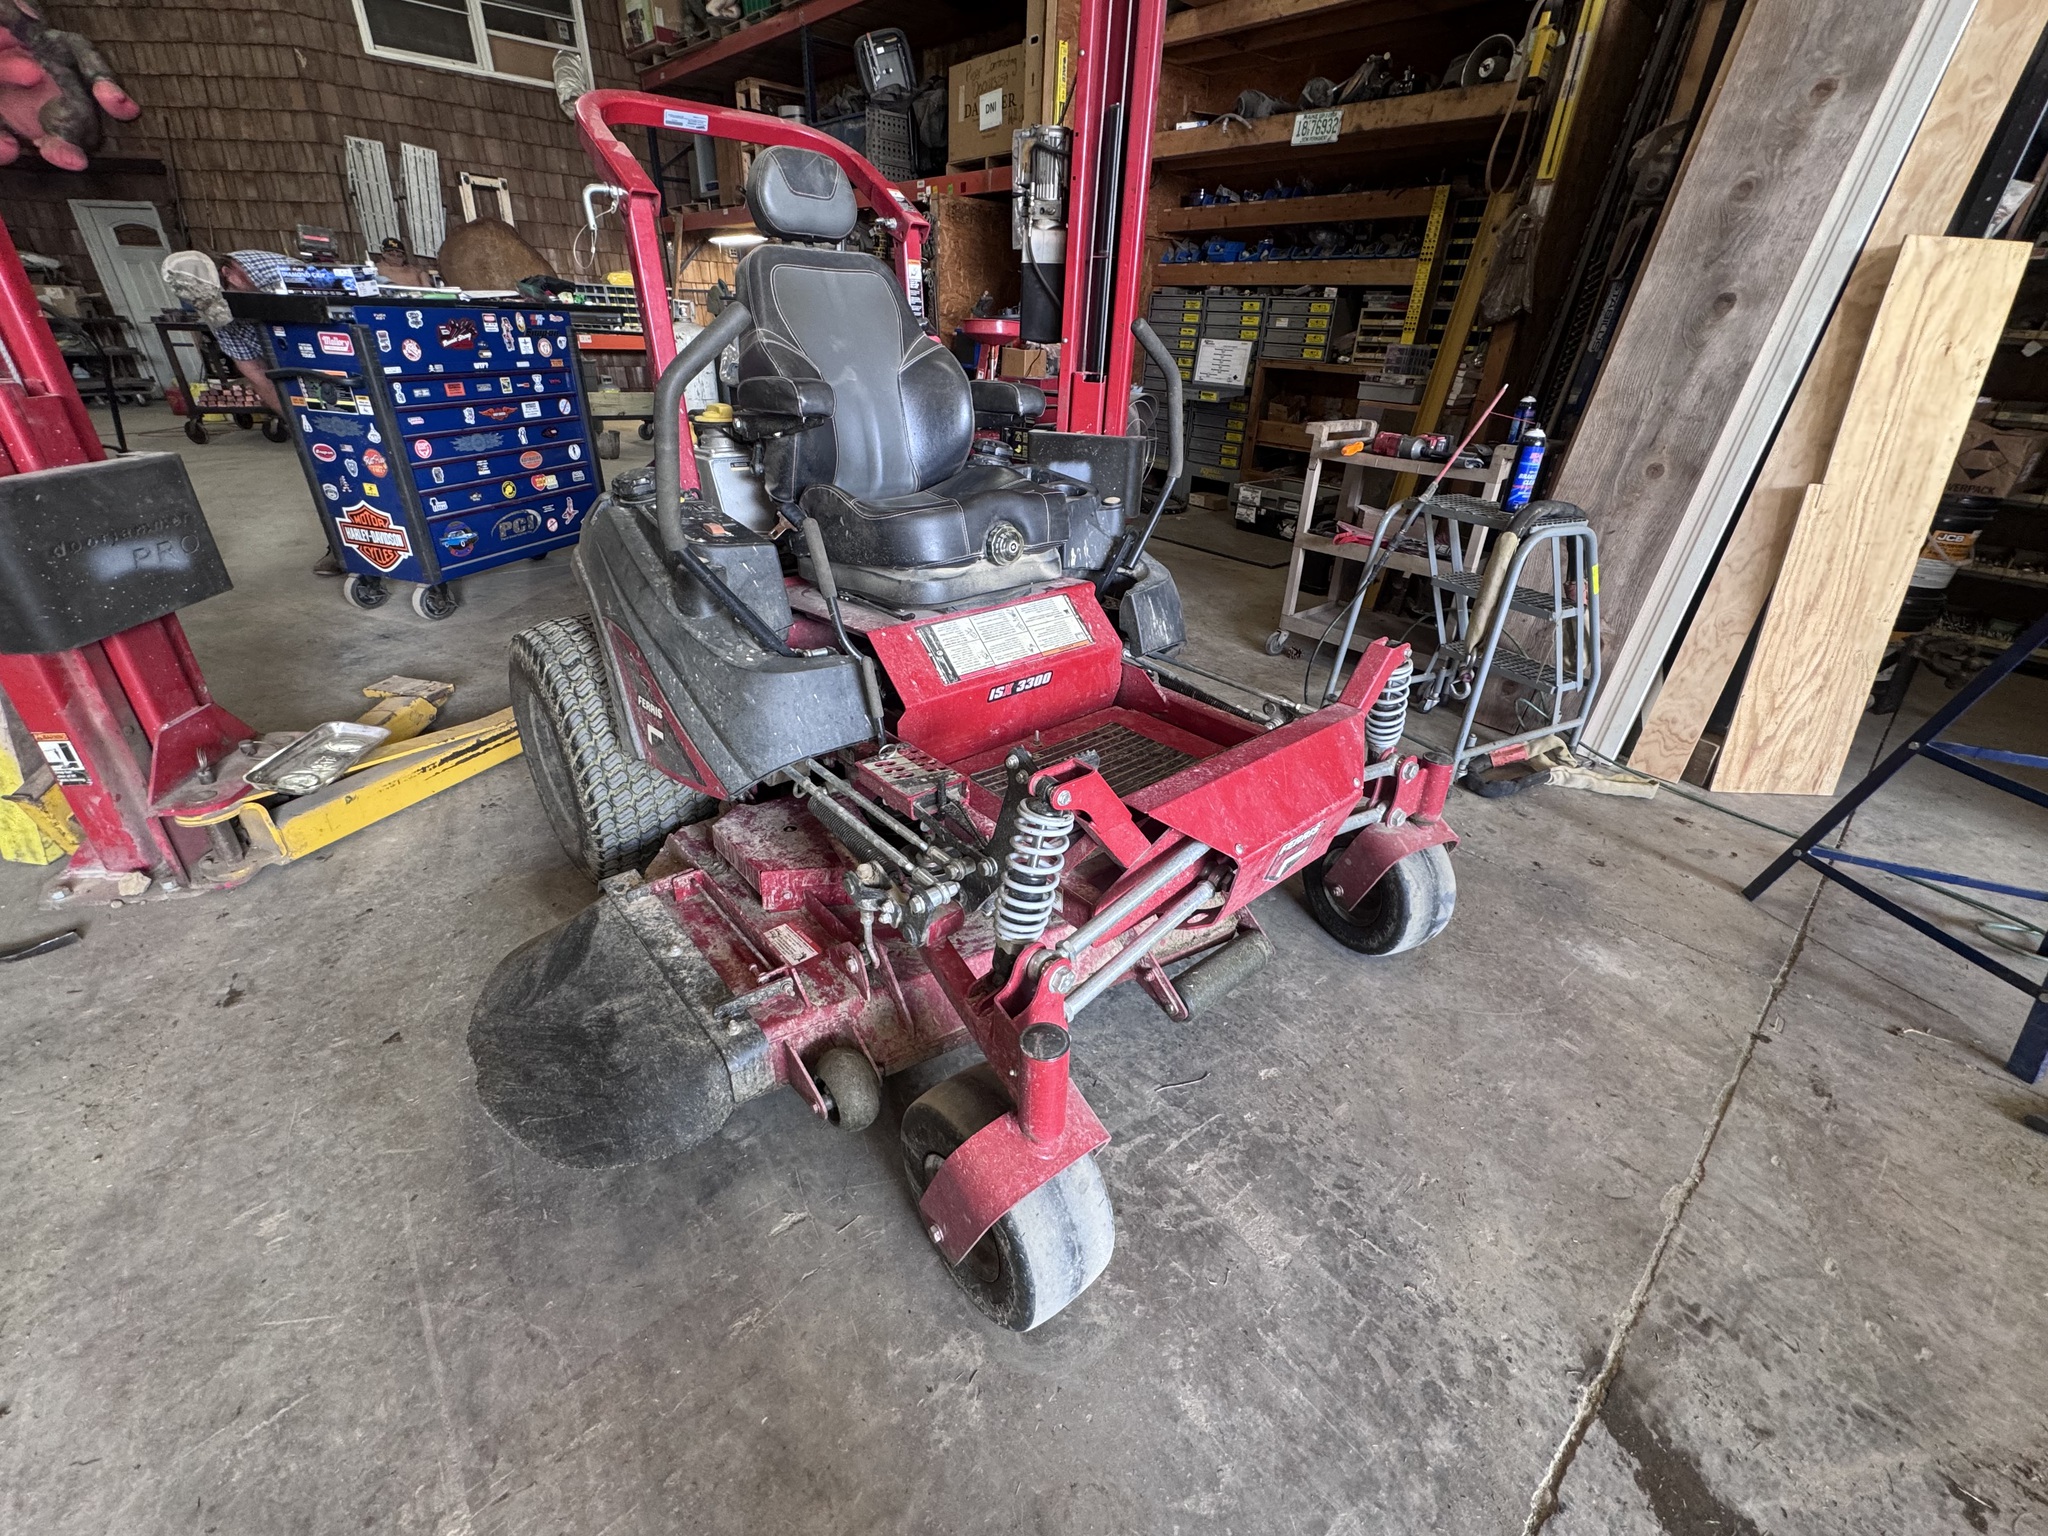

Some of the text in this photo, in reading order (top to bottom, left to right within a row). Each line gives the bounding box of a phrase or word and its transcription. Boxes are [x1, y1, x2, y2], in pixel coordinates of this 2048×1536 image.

[985, 101, 997, 115] DNI
[1946, 482, 1996, 496] VERPACK
[353, 511, 387, 528] MOTOR
[499, 514, 534, 538] PCI
[344, 526, 404, 548] HARLEY-DAVIDSON
[1937, 533, 1965, 543] JCB
[132, 533, 200, 570] PRO
[364, 545, 394, 564] CYCLES
[988, 672, 1052, 702] ISX 3300
[637, 694, 663, 719] FERRIS
[1278, 820, 1324, 855] FERRIS
